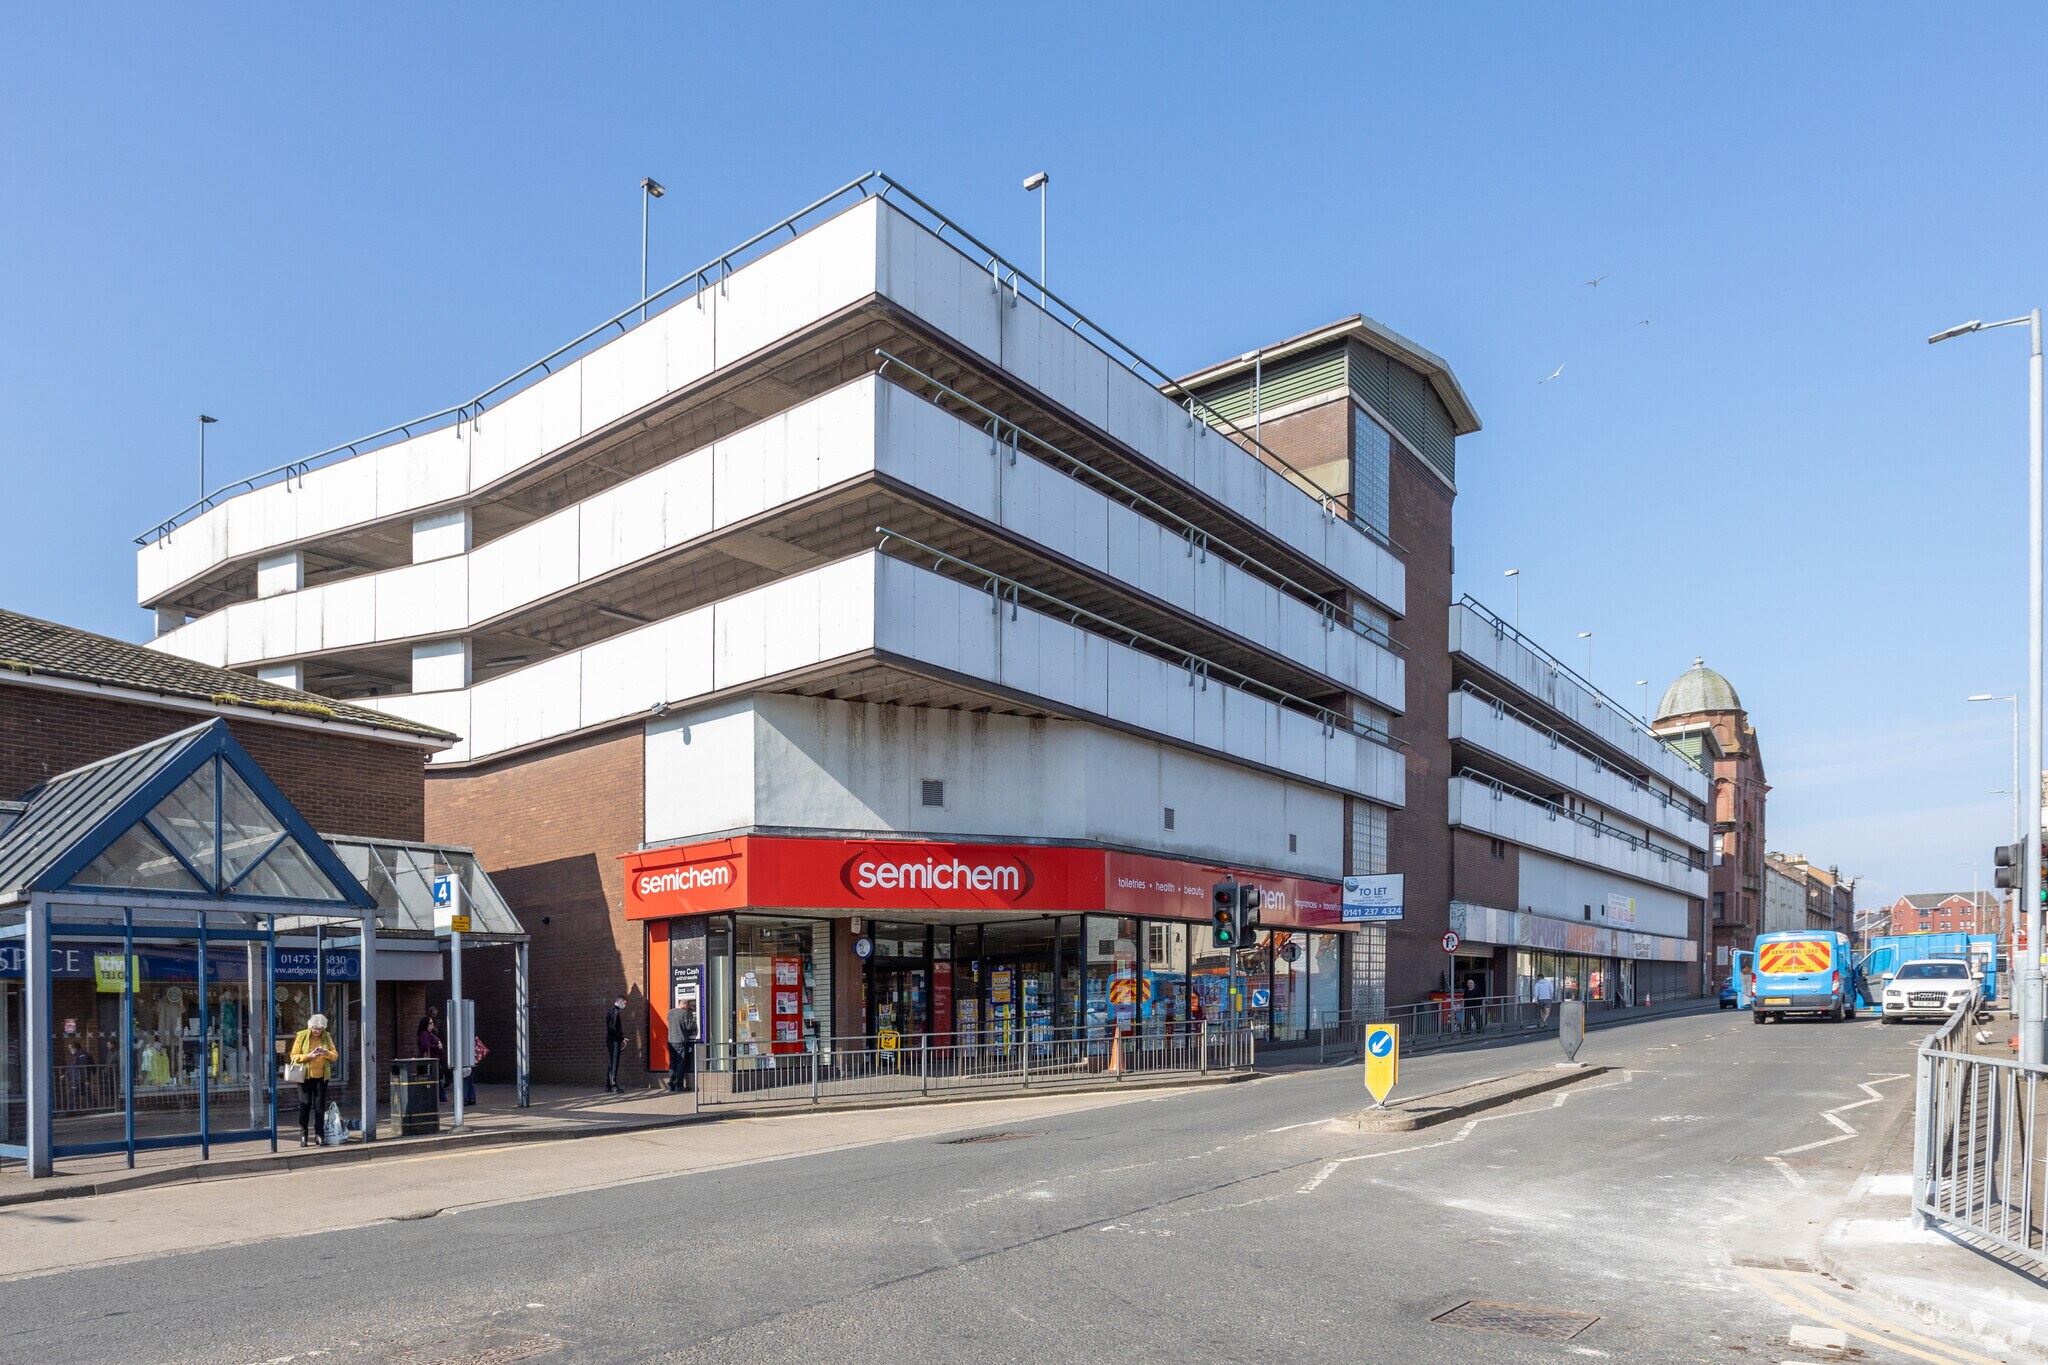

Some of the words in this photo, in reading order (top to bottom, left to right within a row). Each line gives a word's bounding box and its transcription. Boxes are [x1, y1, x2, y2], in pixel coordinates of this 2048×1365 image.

[640, 866, 729, 895] semichem
[858, 857, 1019, 890] semichem
[438, 883, 448, 900] 4
[1118, 877, 1146, 889] toiletries
[1155, 881, 1175, 892] health
[1184, 885, 1204, 898] beauty
[1359, 887, 1372, 896] TO
[1373, 887, 1388, 896] LET
[1343, 908, 1362, 917] 0141
[1364, 907, 1379, 916] 237
[1382, 906, 1402, 915] 4324
[281, 954, 310, 964] 01475
[674, 968, 686, 976] Free
[686, 967, 700, 975] Cash
